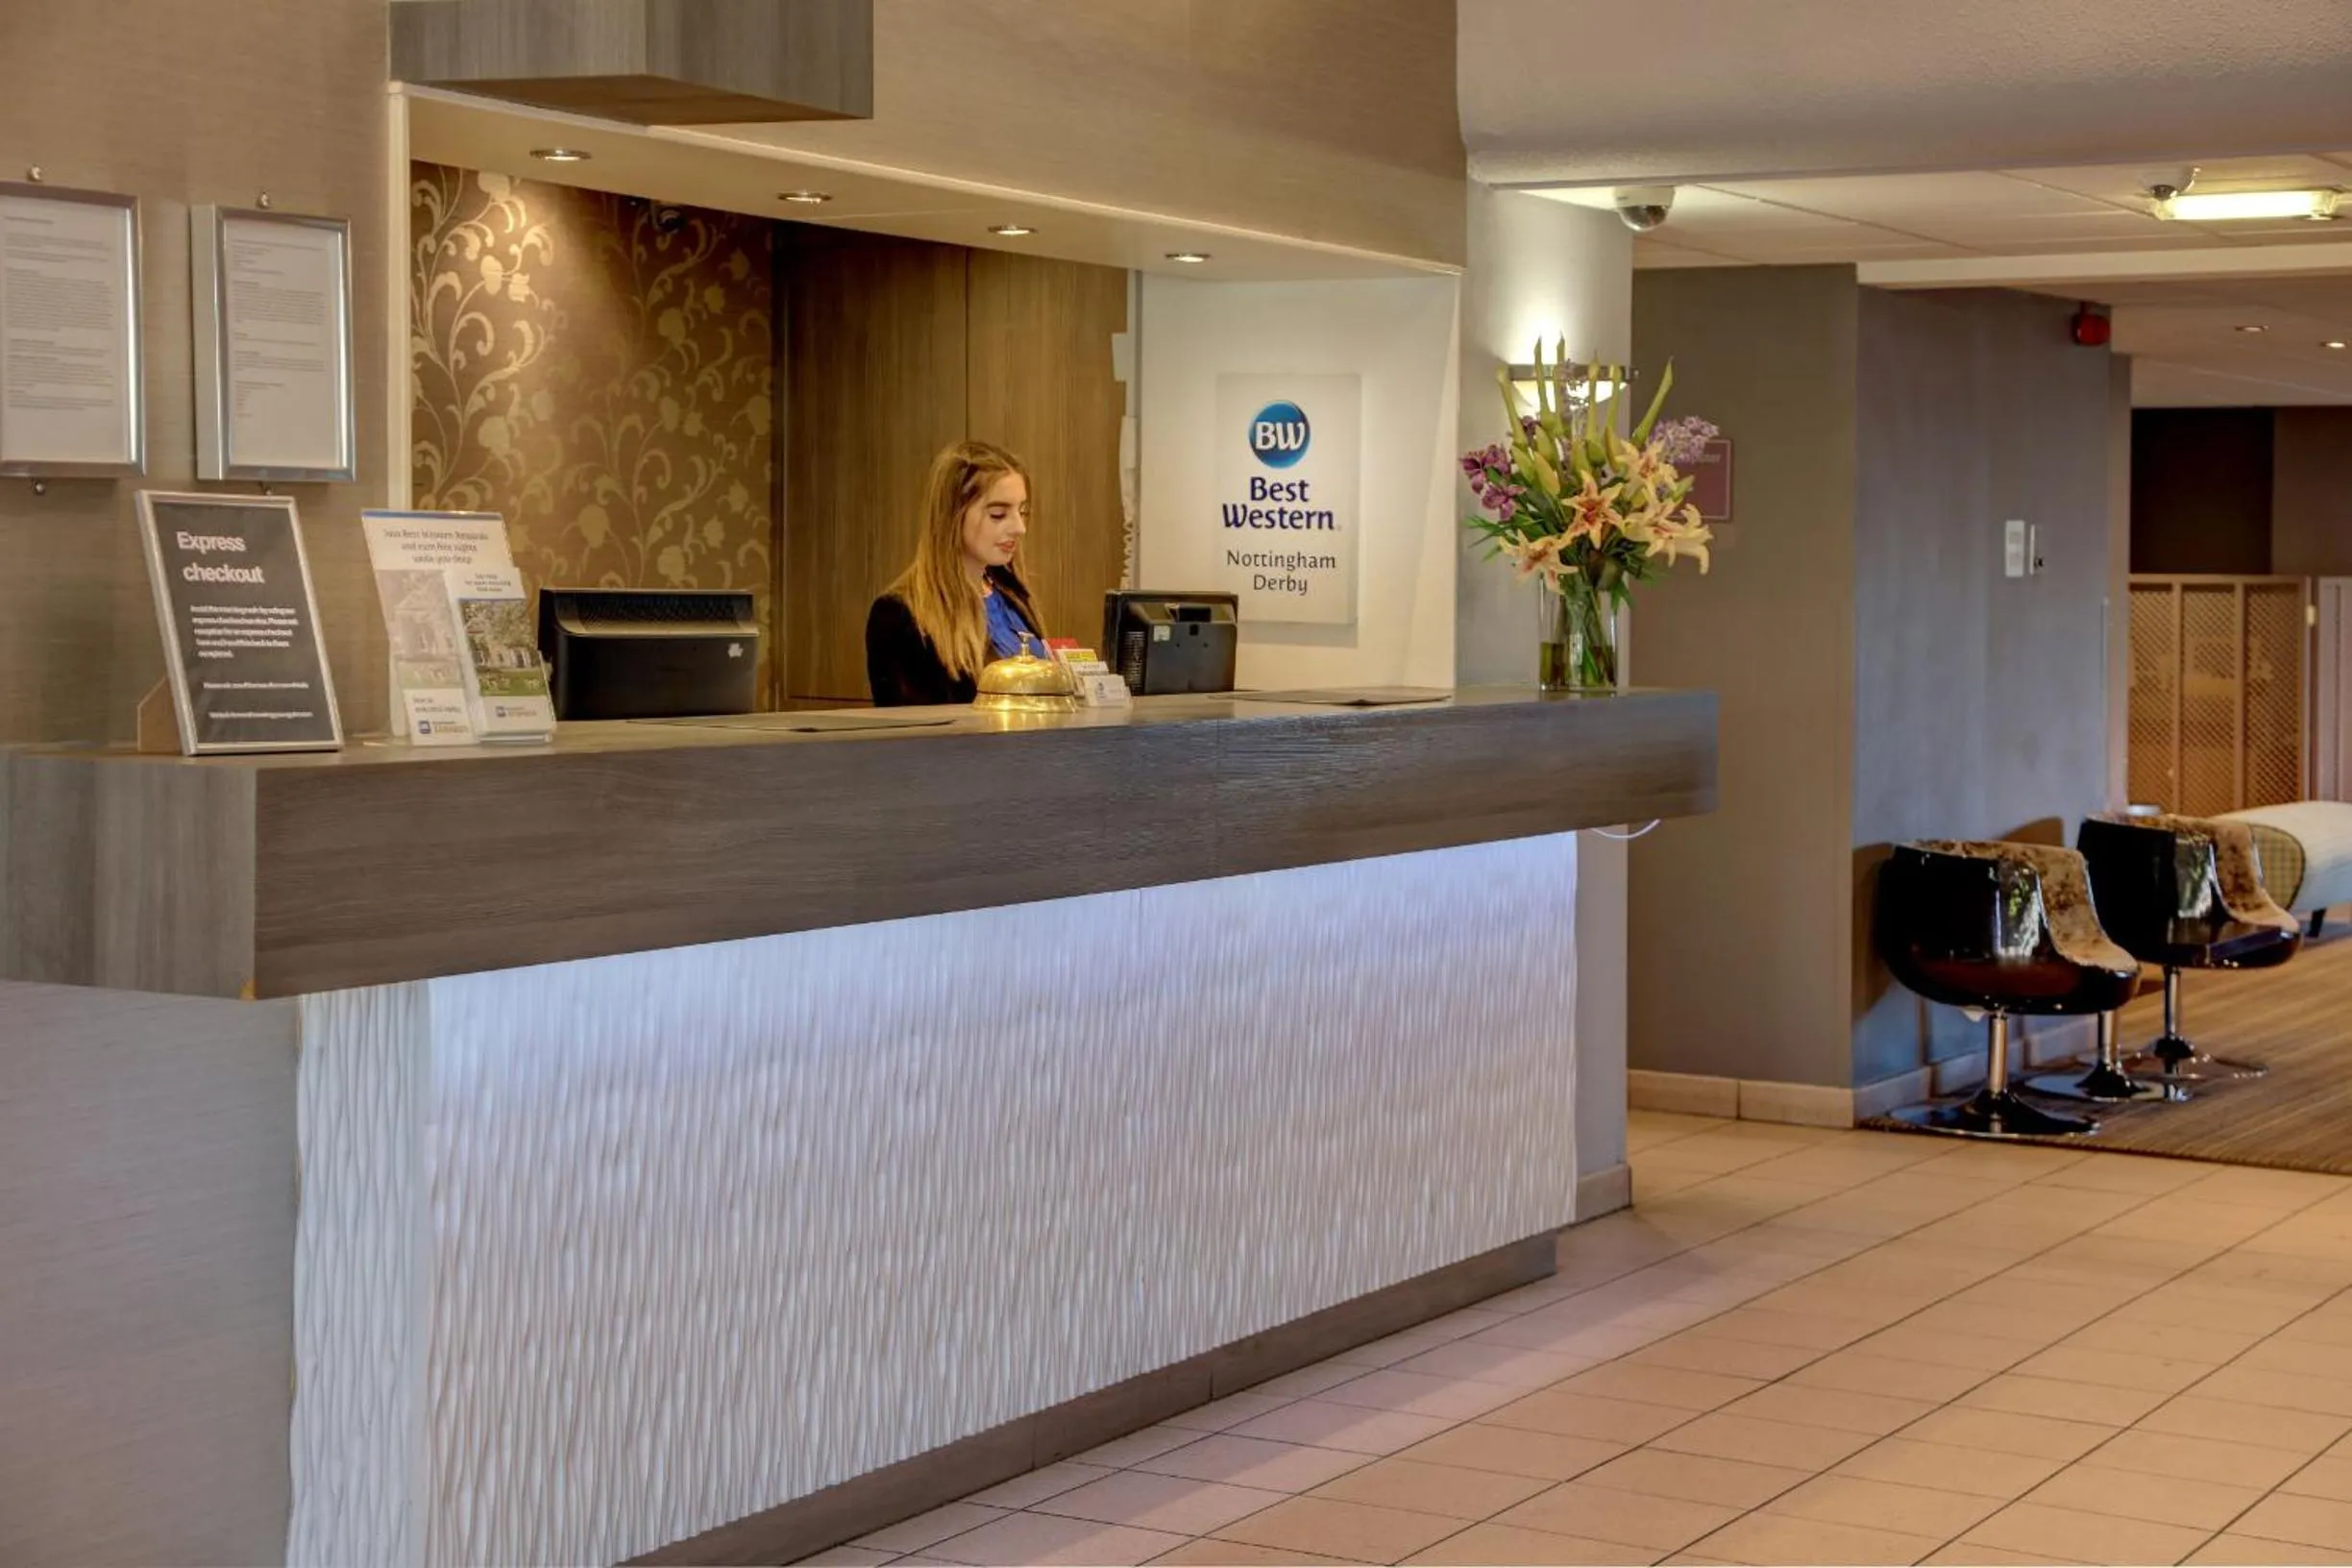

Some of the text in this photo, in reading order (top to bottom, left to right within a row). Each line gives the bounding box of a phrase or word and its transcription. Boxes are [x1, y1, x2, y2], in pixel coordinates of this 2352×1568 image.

[1254, 421, 1306, 451] BW
[1250, 476, 1311, 502] Best
[1222, 502, 1335, 530] Western
[176, 530, 247, 554] Express
[183, 562, 265, 584] checkout
[1226, 549, 1336, 573] Nottingham
[1253, 574, 1309, 597] Derby
